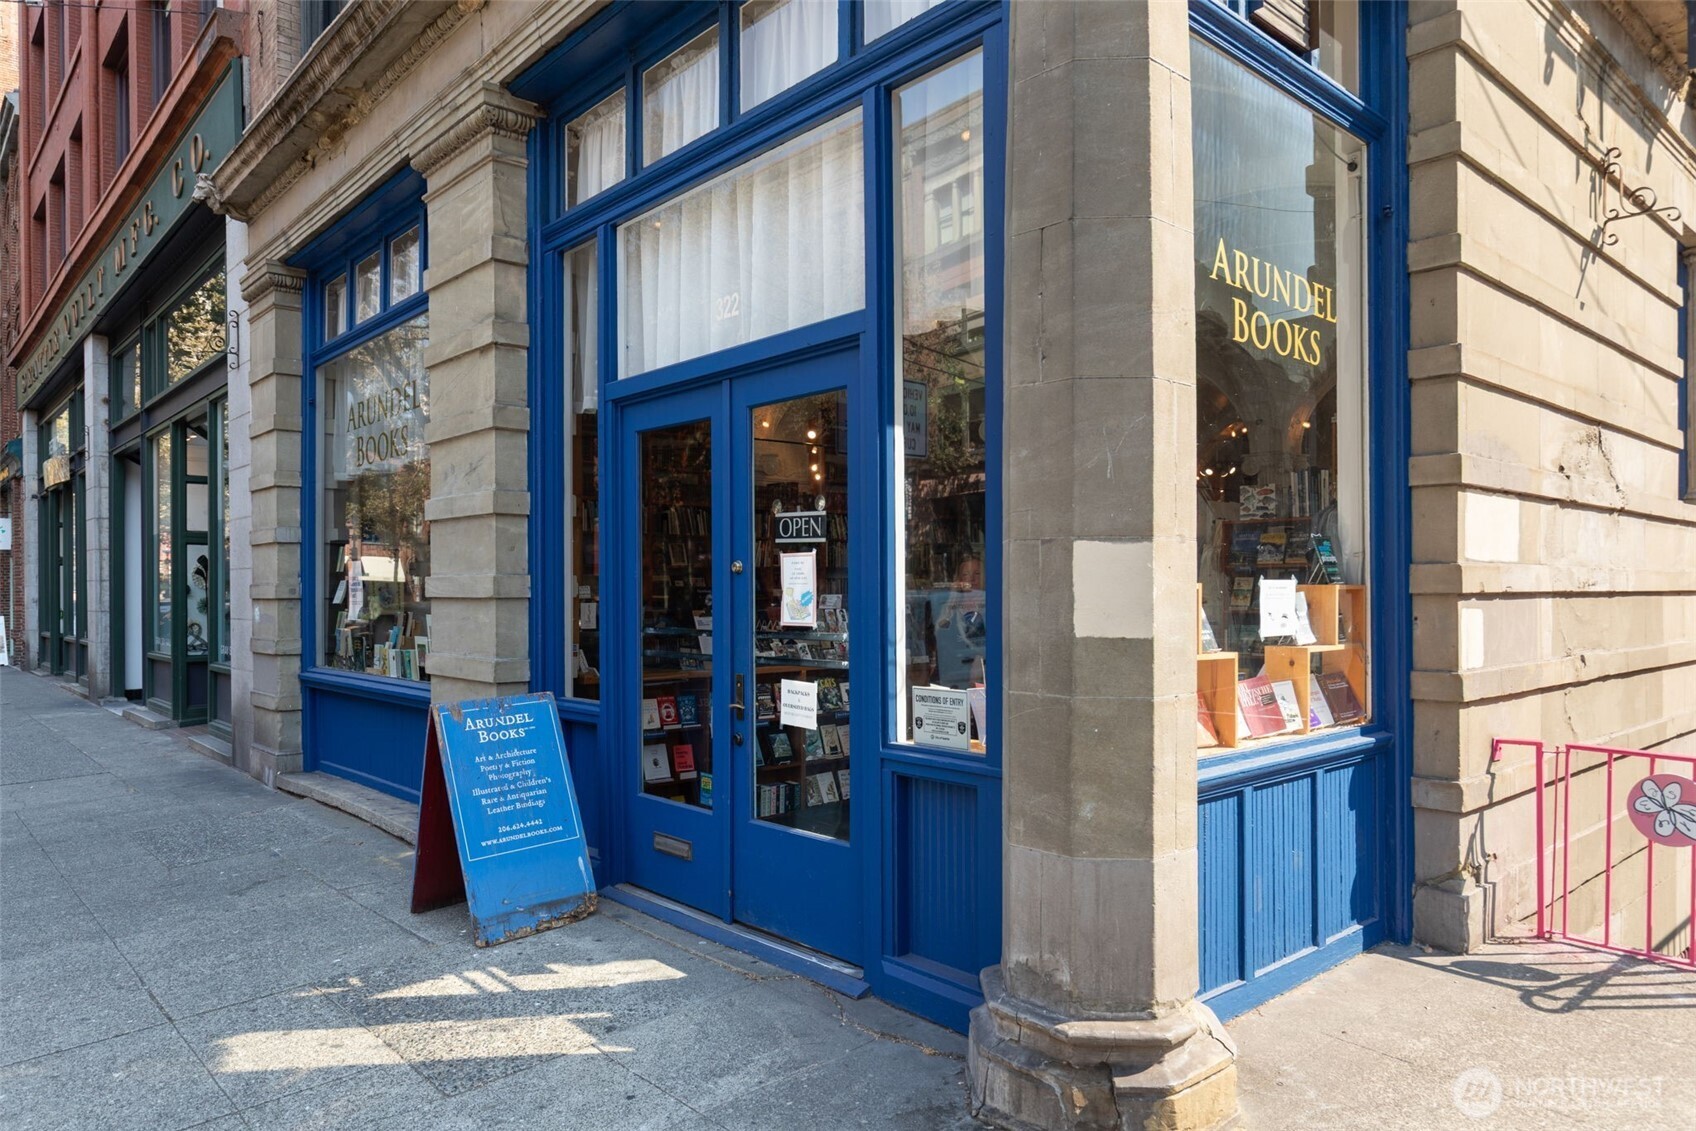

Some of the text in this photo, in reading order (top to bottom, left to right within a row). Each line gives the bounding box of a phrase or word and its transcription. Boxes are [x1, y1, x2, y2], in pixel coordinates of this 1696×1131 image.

[64, 265, 104, 337] QUILT
[114, 200, 160, 277] MFG.
[171, 133, 211, 199] CO.
[1209, 237, 1337, 324] ARUNDEL
[716, 292, 740, 321] 322
[1231, 296, 1321, 366] BOOKS
[347, 379, 421, 434] ARUNDEL
[356, 425, 410, 468] BOOKS
[779, 516, 823, 539] OPEN
[915, 694, 965, 707] CONDITIONS OF ENTRY
[464, 712, 534, 731] ARUNDEL
[478, 727, 526, 743] BOOKS
[475, 753, 486, 763] Art
[495, 748, 537, 760] Architecture
[511, 758, 536, 768] Fiction
[472, 783, 509, 797] Illustrated
[516, 776, 552, 789] Children's
[481, 796, 499, 806] Rare
[506, 788, 548, 801] Antiquarian
[487, 799, 546, 815] Leather Bindings
